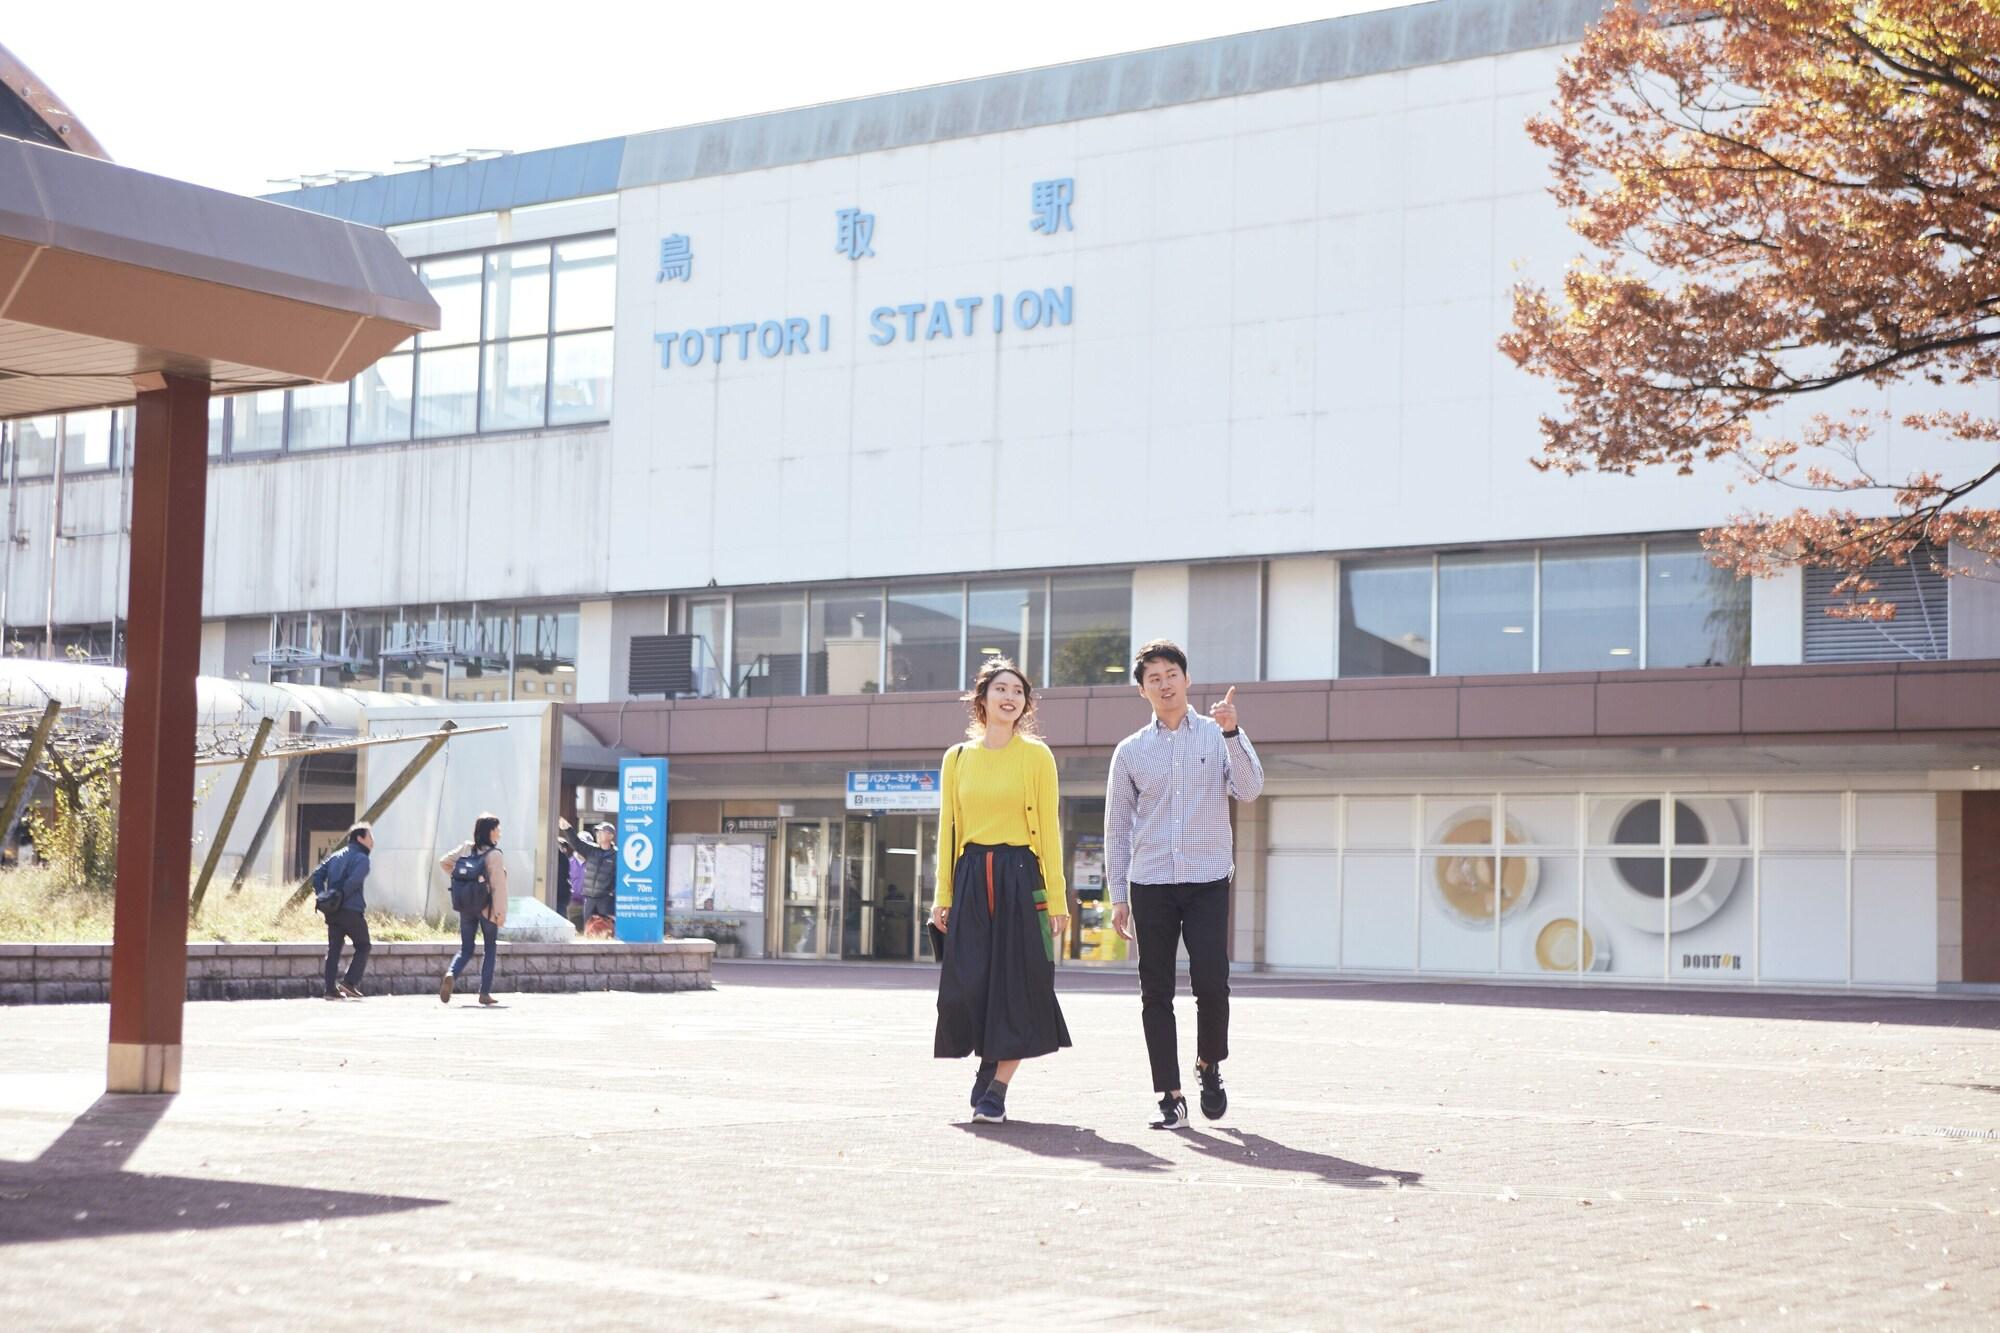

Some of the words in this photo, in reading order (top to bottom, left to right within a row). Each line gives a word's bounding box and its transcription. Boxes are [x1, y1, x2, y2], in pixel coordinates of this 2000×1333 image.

[656, 178, 1074, 283] 鳥取駅
[655, 313, 830, 369] TOTTORI
[869, 286, 1073, 346] STATION
[869, 774, 919, 783] バスターミナル
